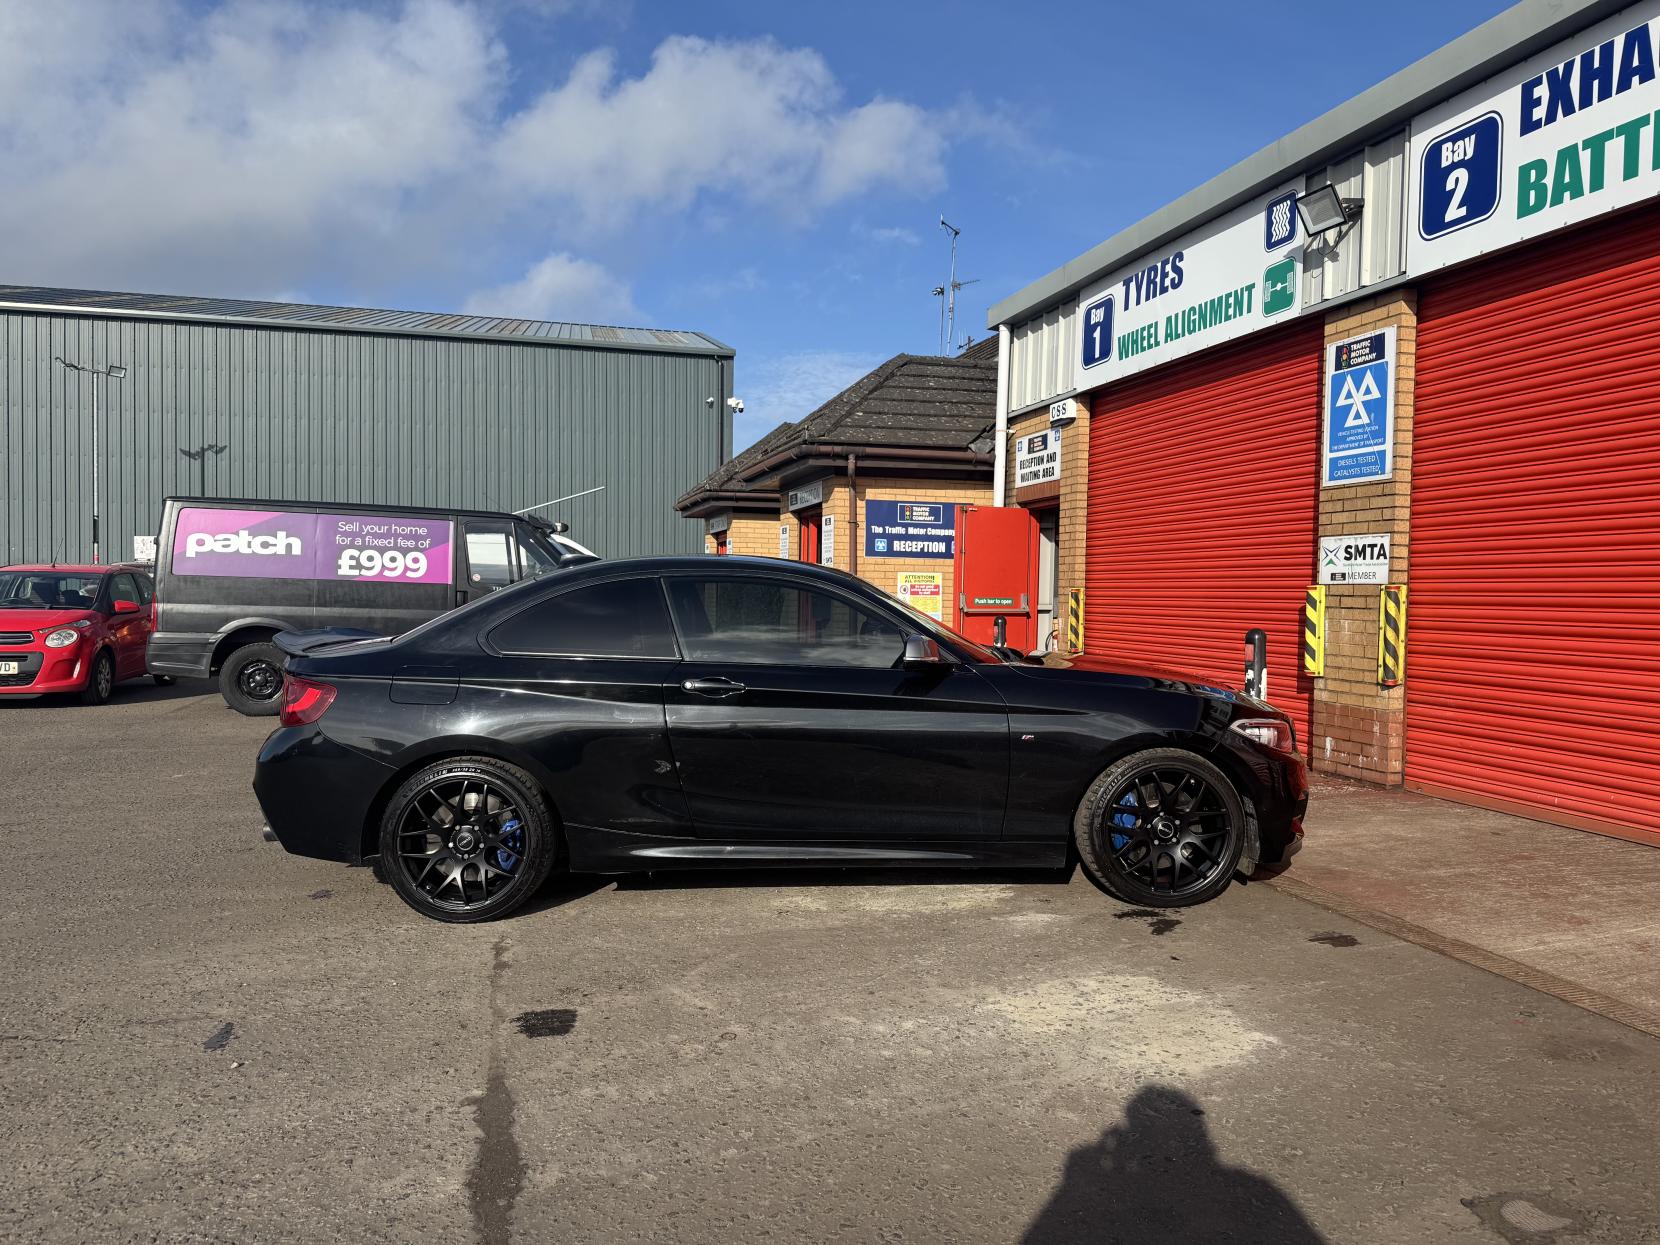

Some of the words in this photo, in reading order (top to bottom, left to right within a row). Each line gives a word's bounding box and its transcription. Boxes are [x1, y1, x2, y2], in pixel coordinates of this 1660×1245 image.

[1519, 22, 1660, 137] EXHA
[1441, 132, 1476, 169] Bay
[1516, 109, 1660, 220] BATT
[1444, 167, 1469, 223] 2
[1122, 251, 1184, 312] TYRES
[1090, 306, 1104, 325] Bay
[1117, 322, 1160, 361] WHEEL
[1164, 282, 1256, 344] ALIGNMENT
[1092, 326, 1101, 359] 1
[1351, 340, 1371, 351] TRAFFIC
[1350, 352, 1376, 365] COMPANY
[1351, 348, 1369, 358] MOTOR
[1020, 454, 1044, 470] RECEPTION
[1046, 451, 1057, 464] AND
[1338, 457, 1357, 467] DIESELS
[1358, 455, 1376, 464] TESTED
[1021, 469, 1040, 483] WAITING
[1042, 466, 1054, 479] AREA
[1333, 467, 1360, 478] CATALYSTS
[1362, 465, 1379, 474] TESTED
[337, 521, 359, 533] Sell
[361, 524, 389, 536] your
[391, 523, 428, 535] home
[871, 525, 883, 534] The
[884, 526, 906, 534] Traffic
[907, 526, 927, 535] Motor
[926, 527, 955, 537] Company
[185, 529, 302, 558] patch
[335, 534, 352, 546] for
[354, 538, 362, 546] a
[364, 535, 394, 547] fixed
[396, 536, 416, 548] fee
[417, 537, 431, 549] of
[893, 540, 946, 553] RECEPTION
[1344, 543, 1388, 561] SMTA
[336, 548, 428, 578] £999
[1347, 571, 1377, 580] MEMBER
